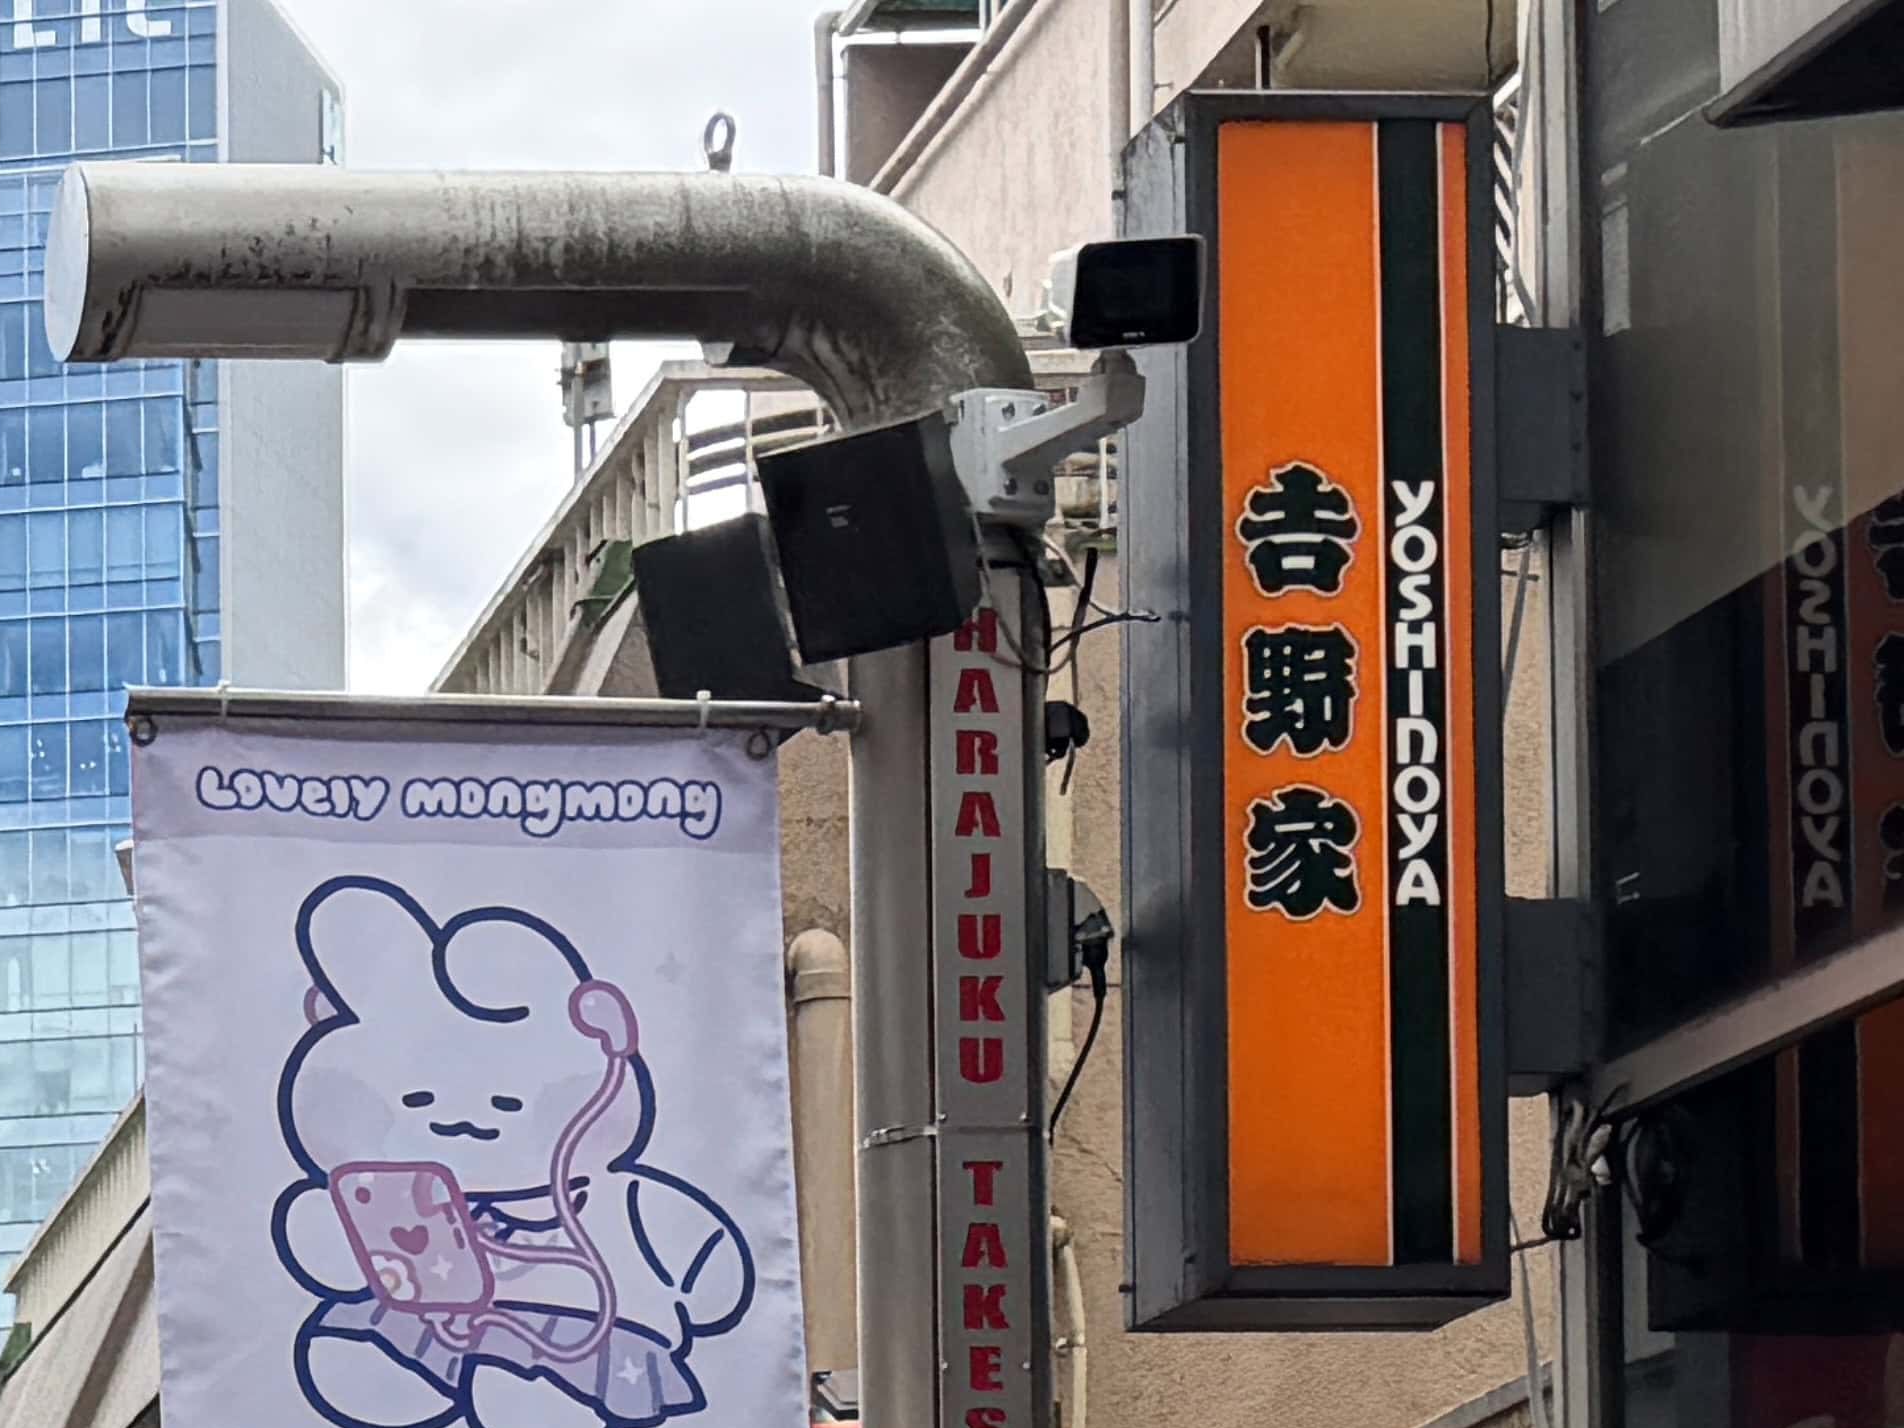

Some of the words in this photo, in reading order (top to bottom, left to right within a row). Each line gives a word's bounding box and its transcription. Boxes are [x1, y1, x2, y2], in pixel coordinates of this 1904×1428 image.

[952, 606, 1005, 1085] HARAJUKU
[1236, 461, 1363, 920] 吉野家
[1391, 479, 1441, 906] YOSHINOYA
